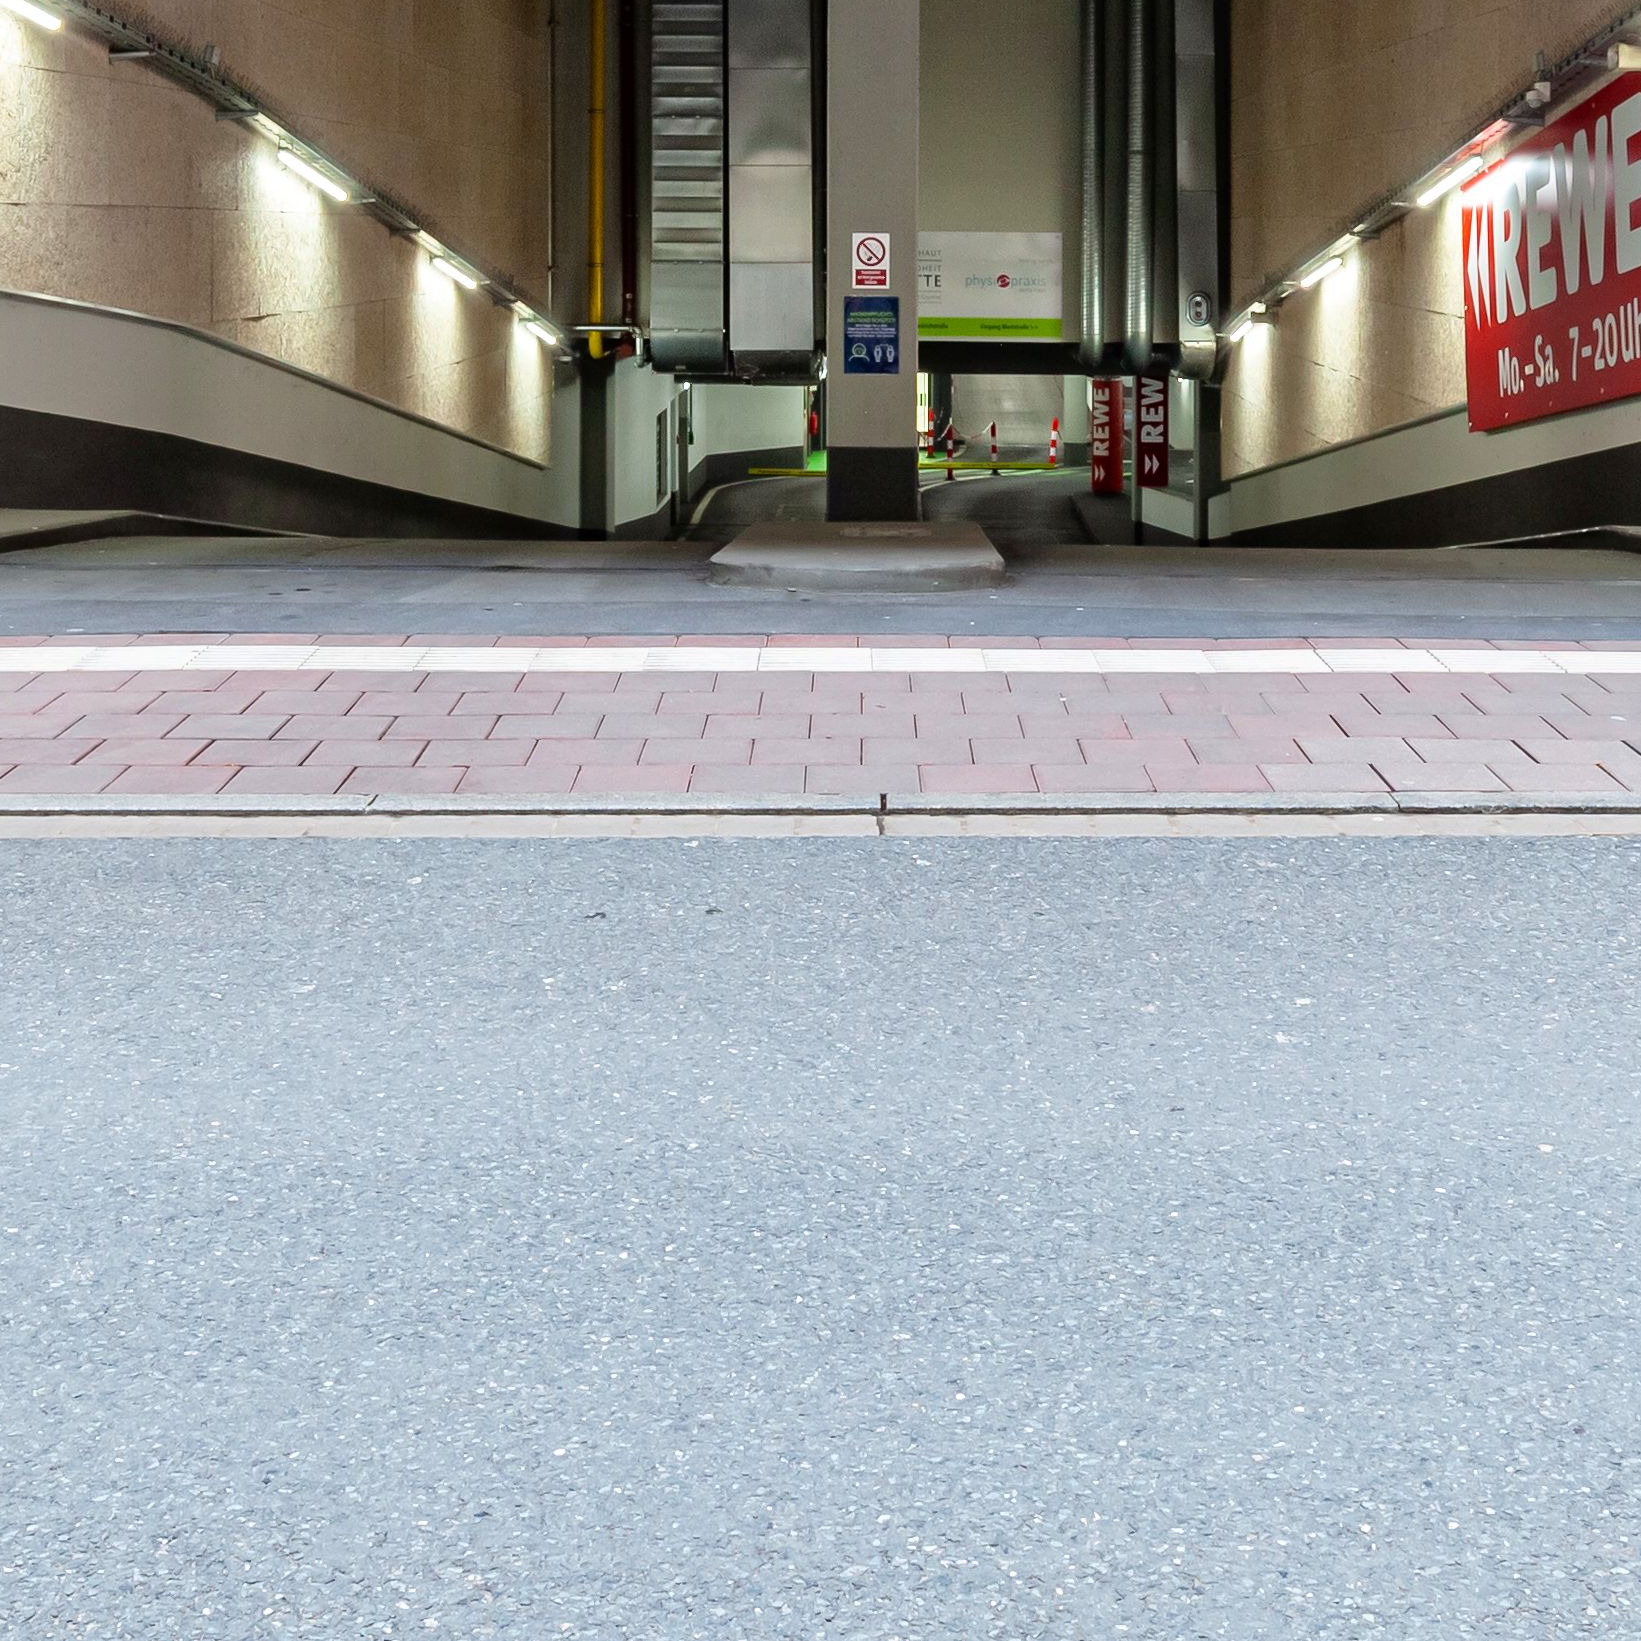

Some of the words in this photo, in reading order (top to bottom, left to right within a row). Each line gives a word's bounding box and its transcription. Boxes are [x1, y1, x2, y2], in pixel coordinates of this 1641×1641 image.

[1498, 334, 1559, 398] Mo.-Sa.
[1093, 387, 1110, 457] REWE
[1141, 377, 1164, 443] REW
